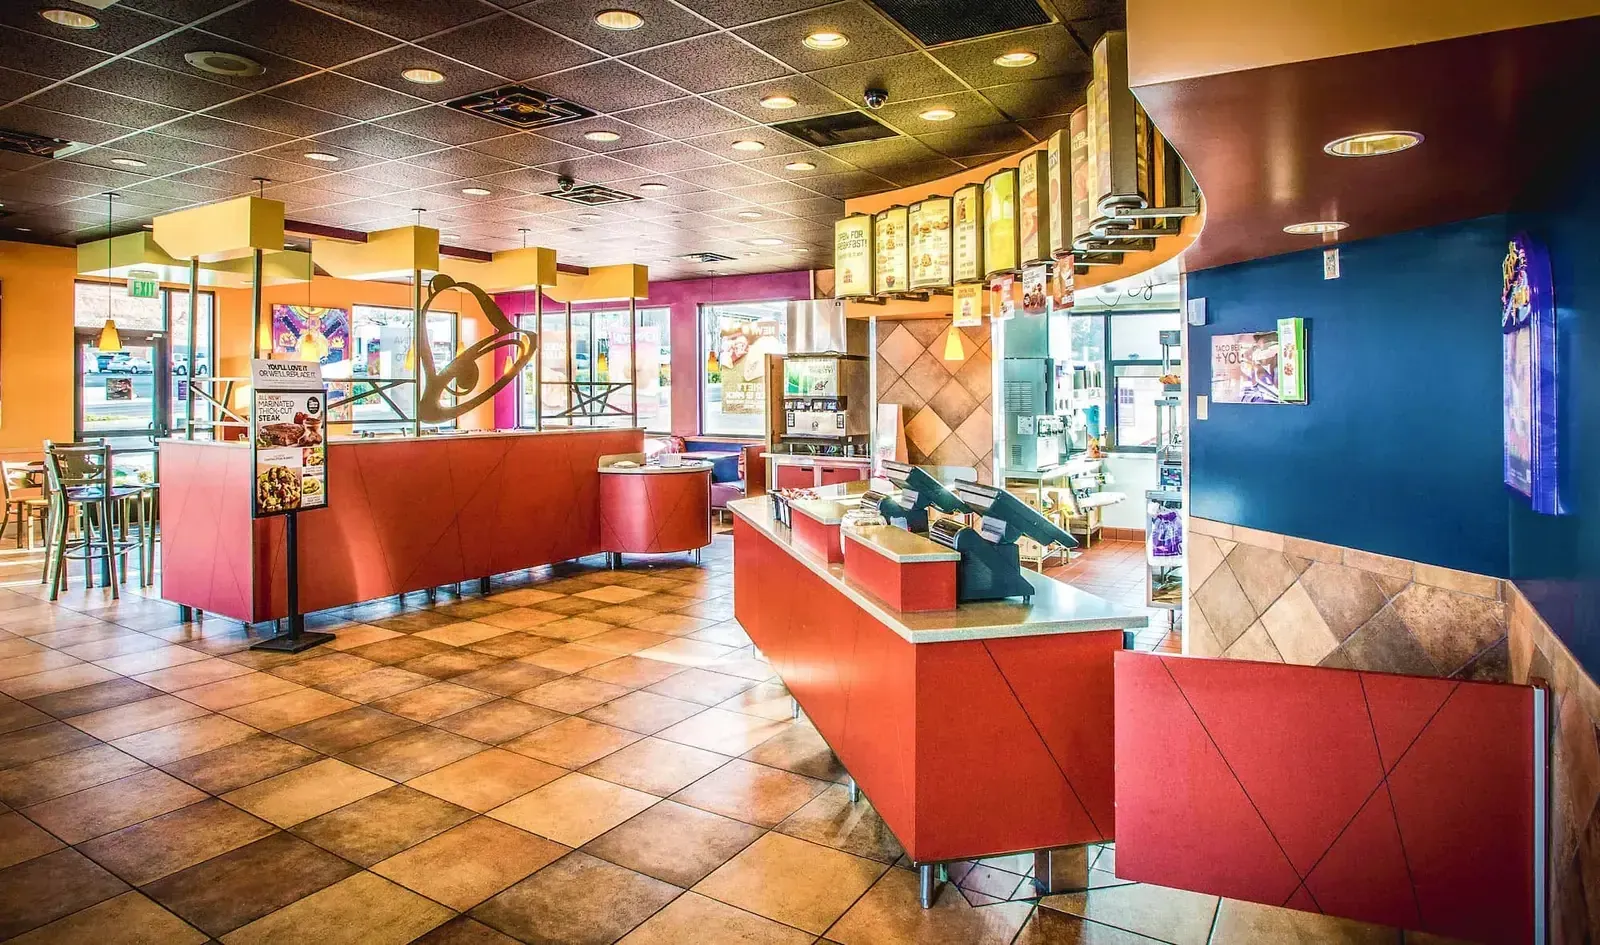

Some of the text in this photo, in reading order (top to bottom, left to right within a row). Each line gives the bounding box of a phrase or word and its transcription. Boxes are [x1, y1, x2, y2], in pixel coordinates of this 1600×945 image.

[850, 230, 864, 239] FOR
[133, 281, 156, 297] EXIT
[267, 363, 288, 371] YOU'LL
[288, 364, 302, 372] LOVE
[269, 370, 286, 378] WE'LL
[258, 400, 294, 408] MARINATED
[258, 407, 292, 415] THICK-CUT
